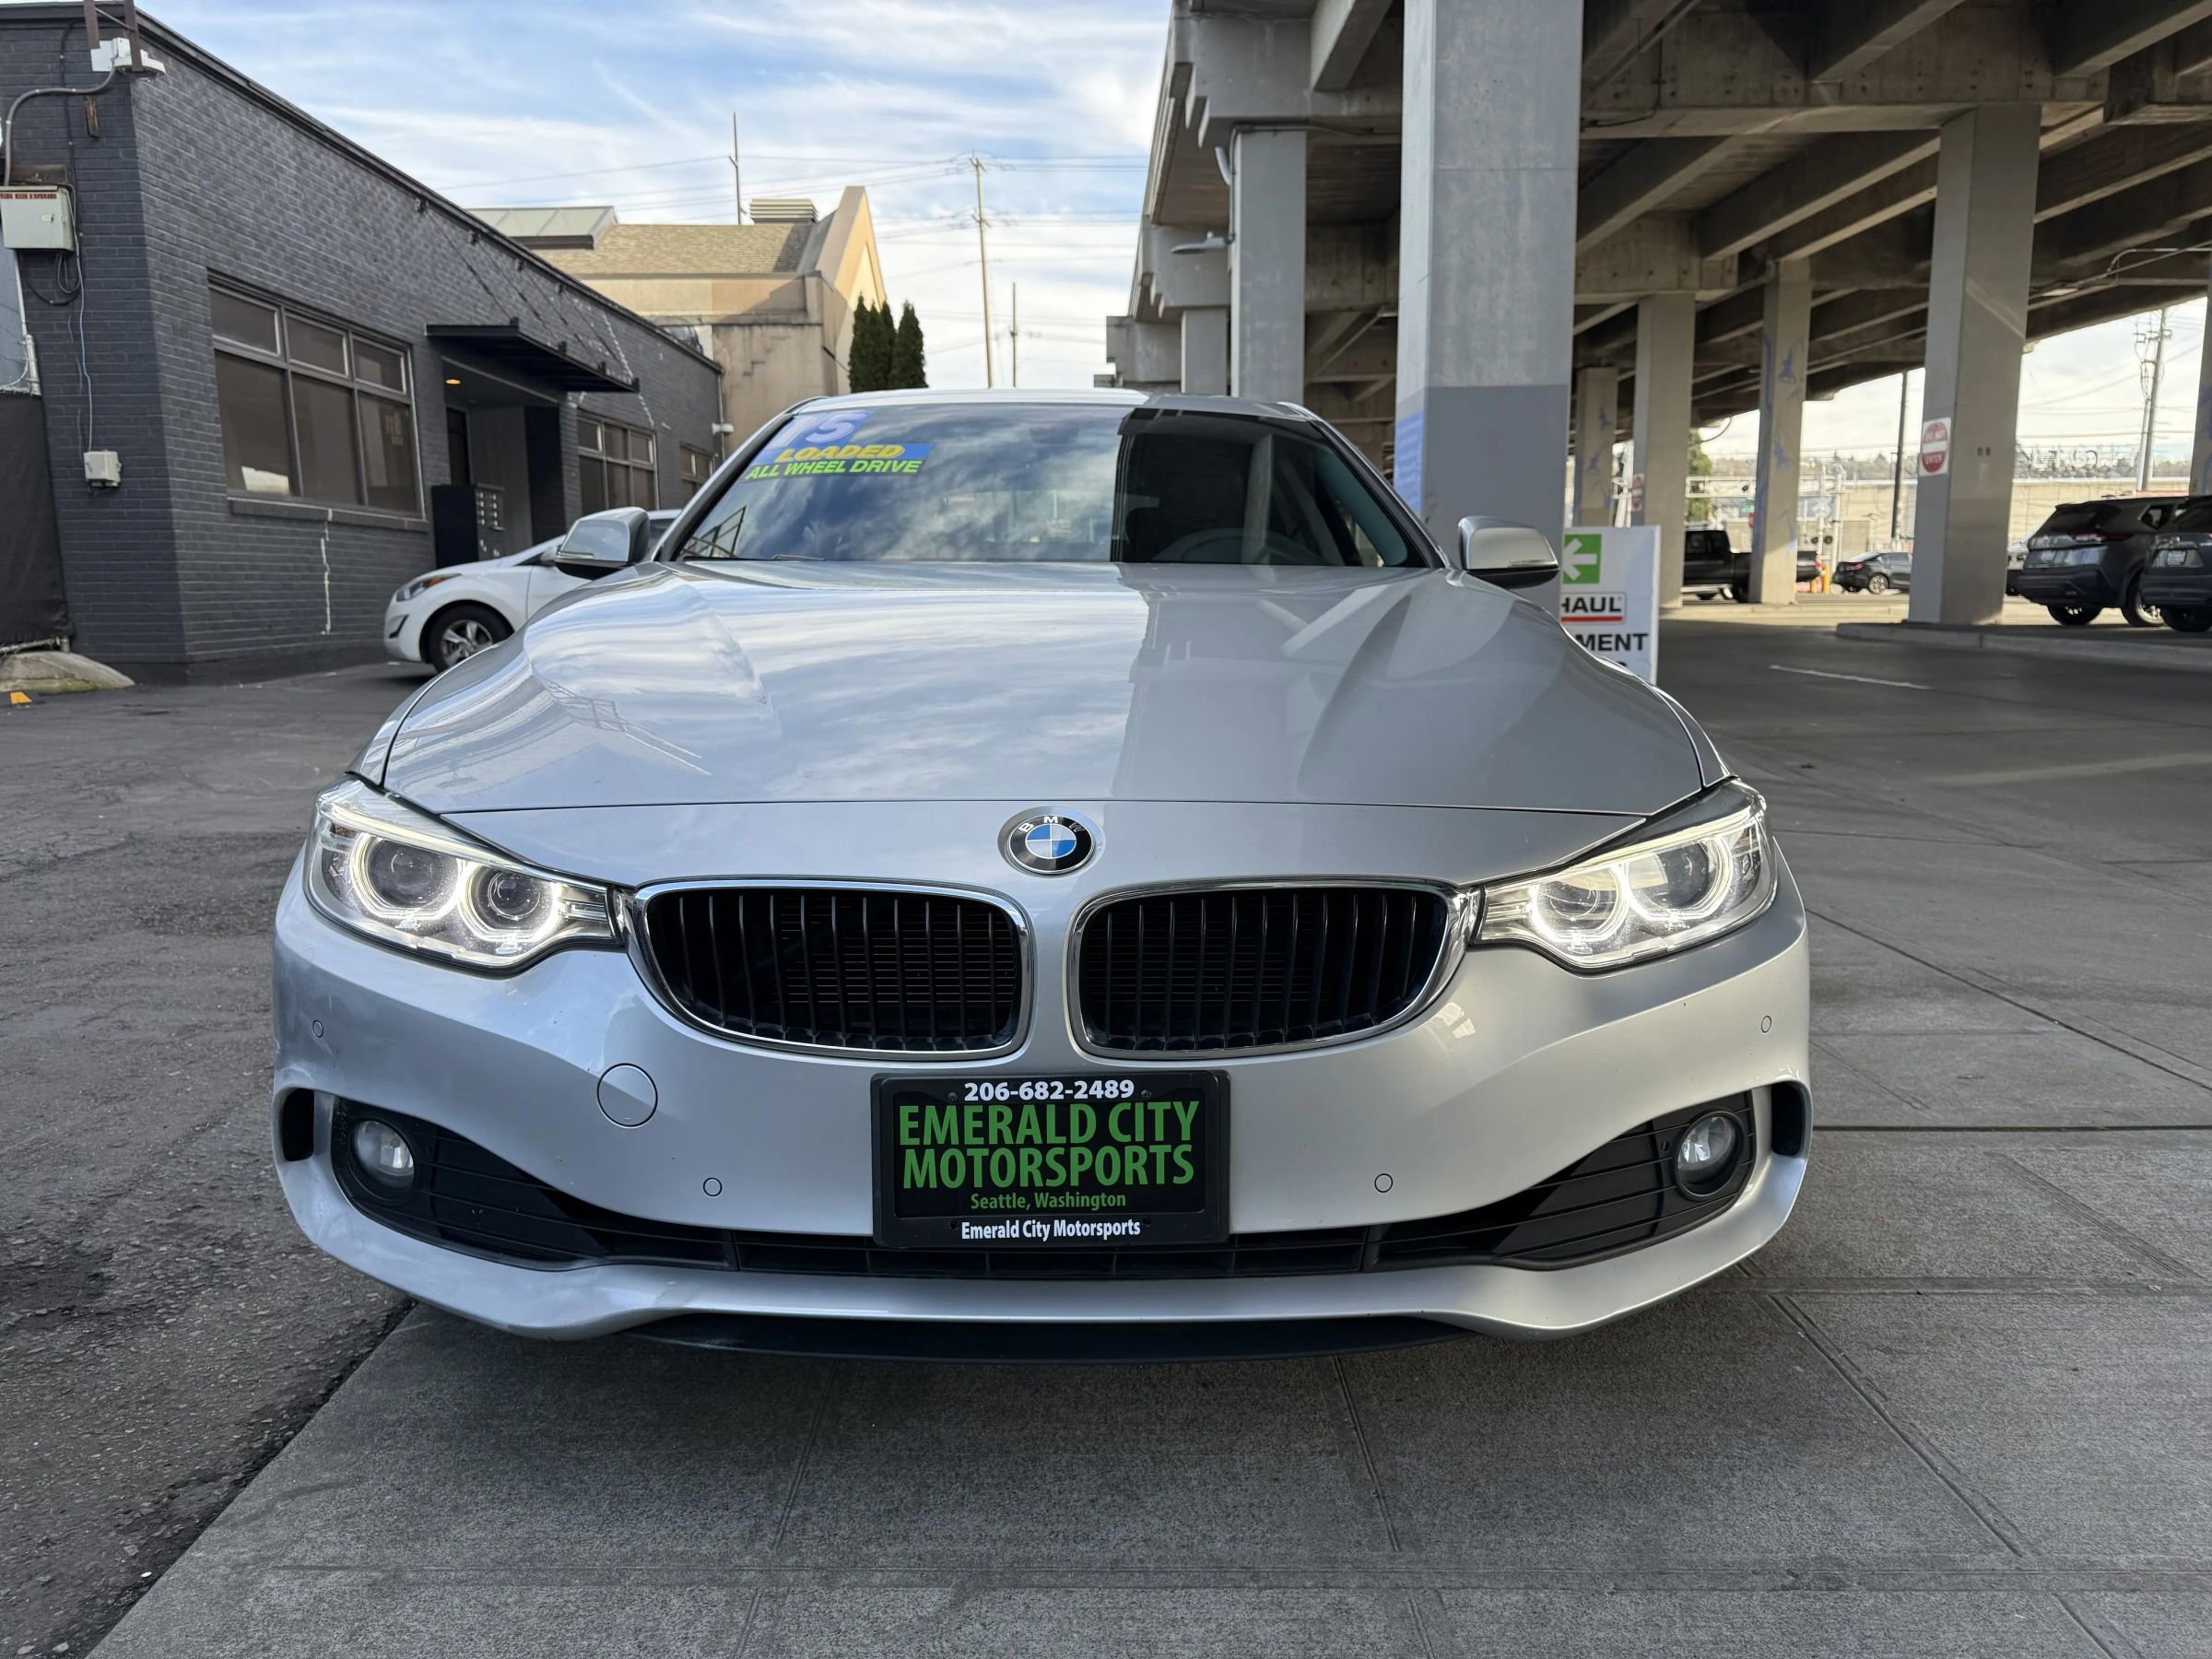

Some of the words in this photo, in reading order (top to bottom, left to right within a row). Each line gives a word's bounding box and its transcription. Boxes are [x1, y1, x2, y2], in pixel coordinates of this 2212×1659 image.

[774, 444, 906, 463] LOADED
[745, 464, 781, 480] ALL
[784, 460, 847, 476] WHEEL
[849, 460, 923, 473] DRIVE
[1018, 816, 1085, 833] BMW
[964, 1079, 1135, 1101] 206-682-2489
[899, 1103, 1097, 1146] EMERALD
[1108, 1100, 1199, 1142] CITY
[902, 1144, 1194, 1189] MOTORSPORTS
[971, 1192, 1031, 1210] Seattle,
[1034, 1192, 1126, 1211] Washington
[961, 1219, 1019, 1240] Emerald
[1022, 1219, 1051, 1241] City
[1053, 1218, 1141, 1241] Motorsports
